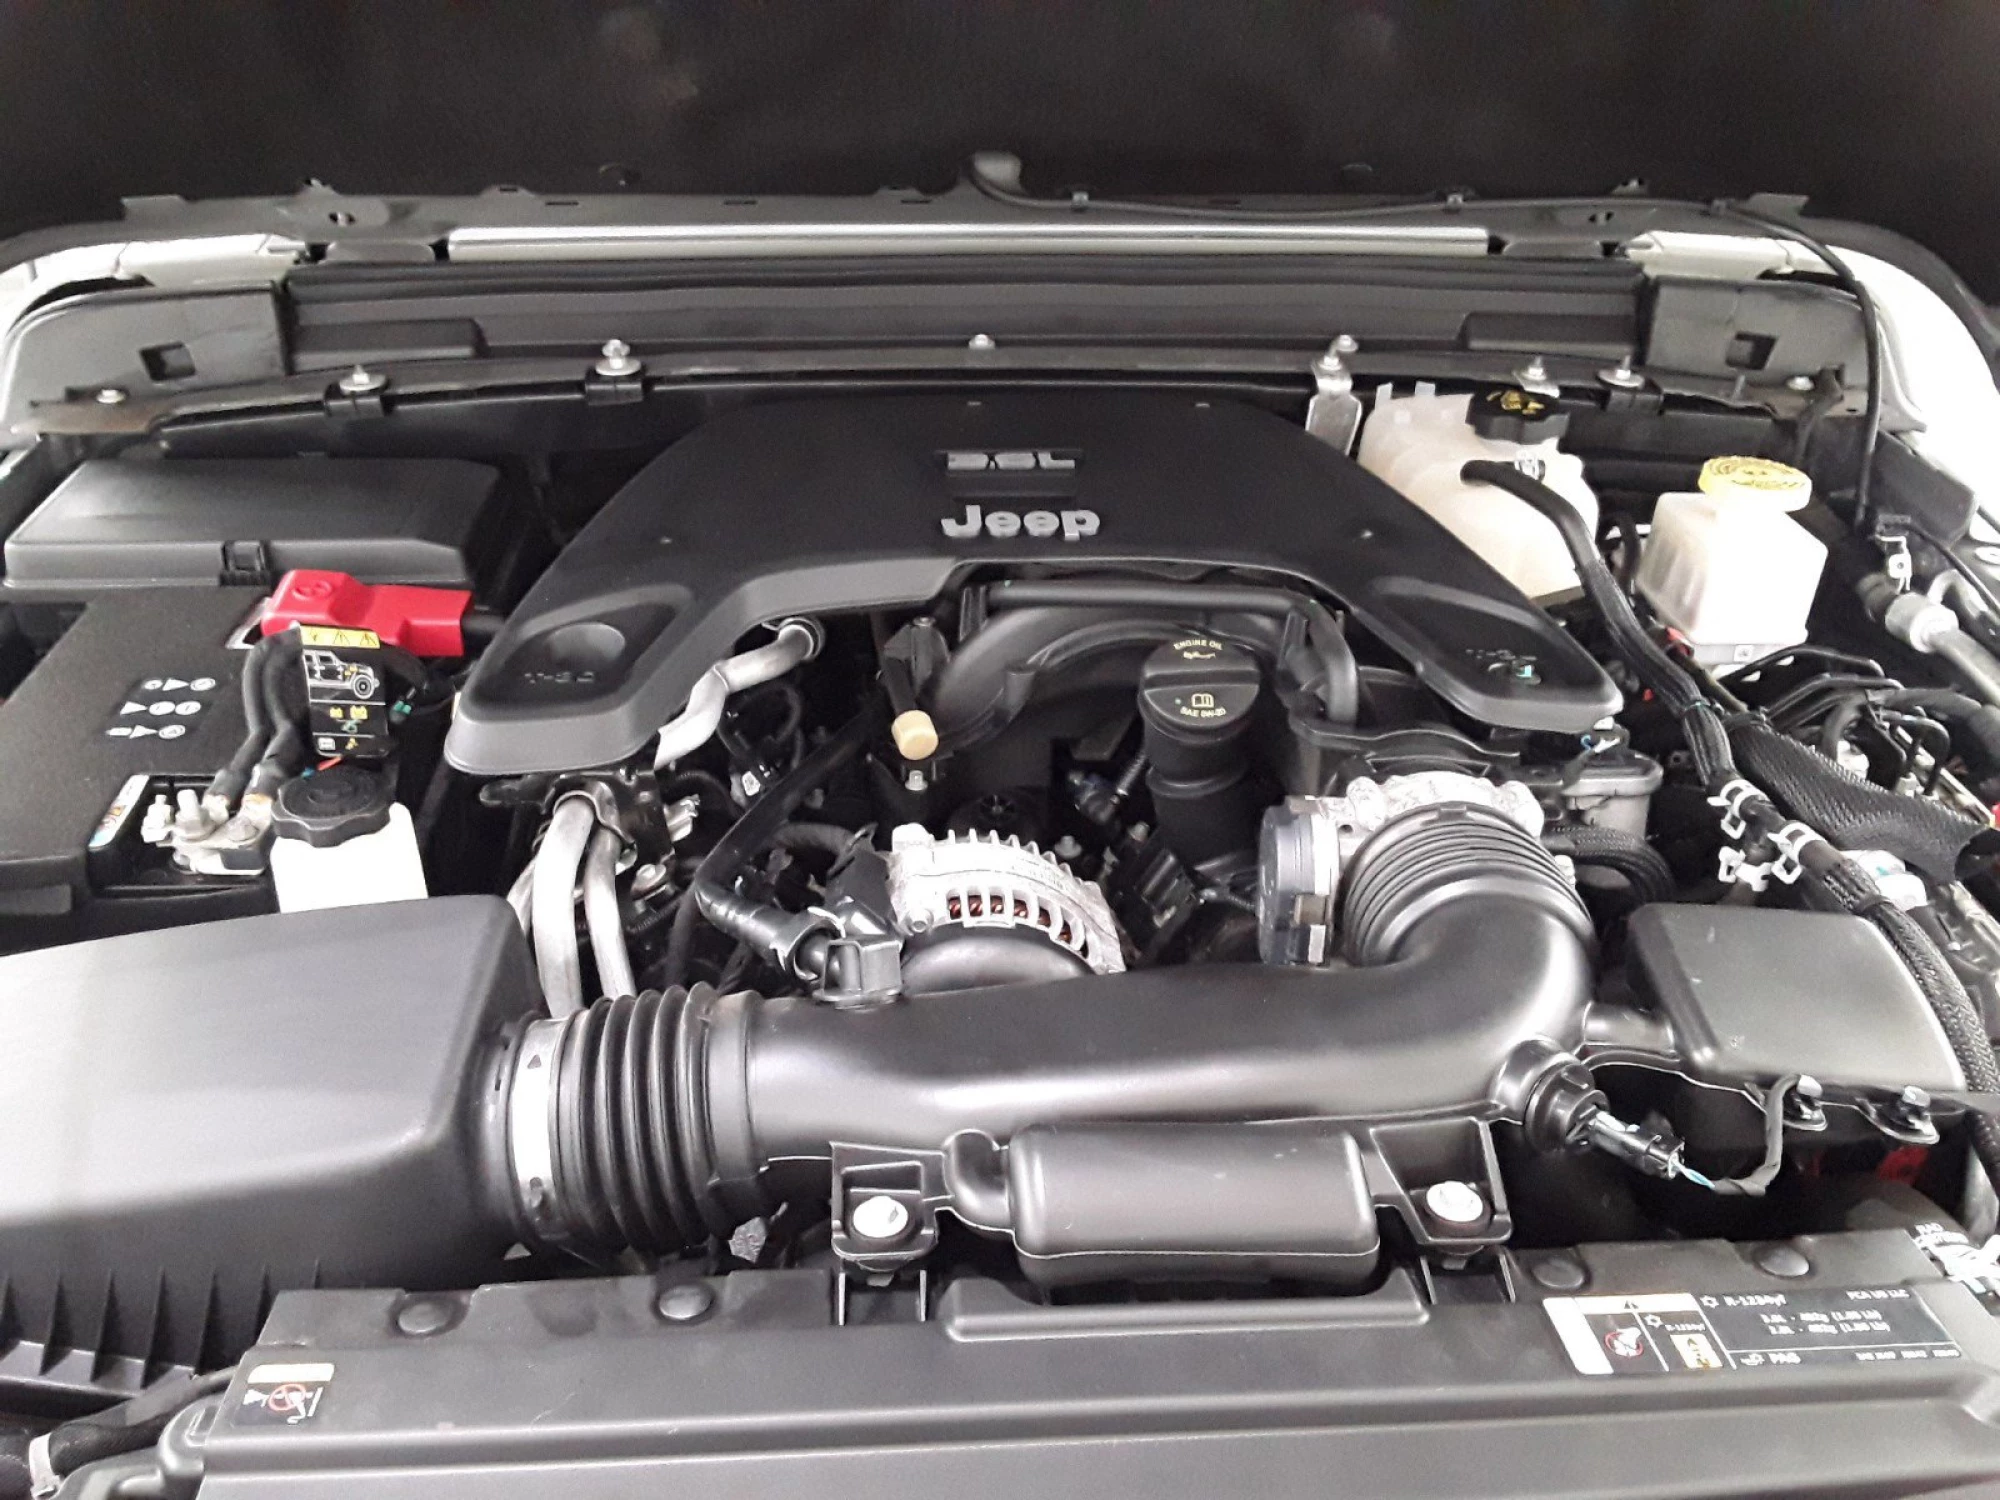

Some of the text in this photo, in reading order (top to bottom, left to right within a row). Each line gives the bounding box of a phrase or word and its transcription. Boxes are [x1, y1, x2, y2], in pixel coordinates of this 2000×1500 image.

[941, 504, 1101, 541] Jeep
[1173, 639, 1223, 650] ENGINE OIL
